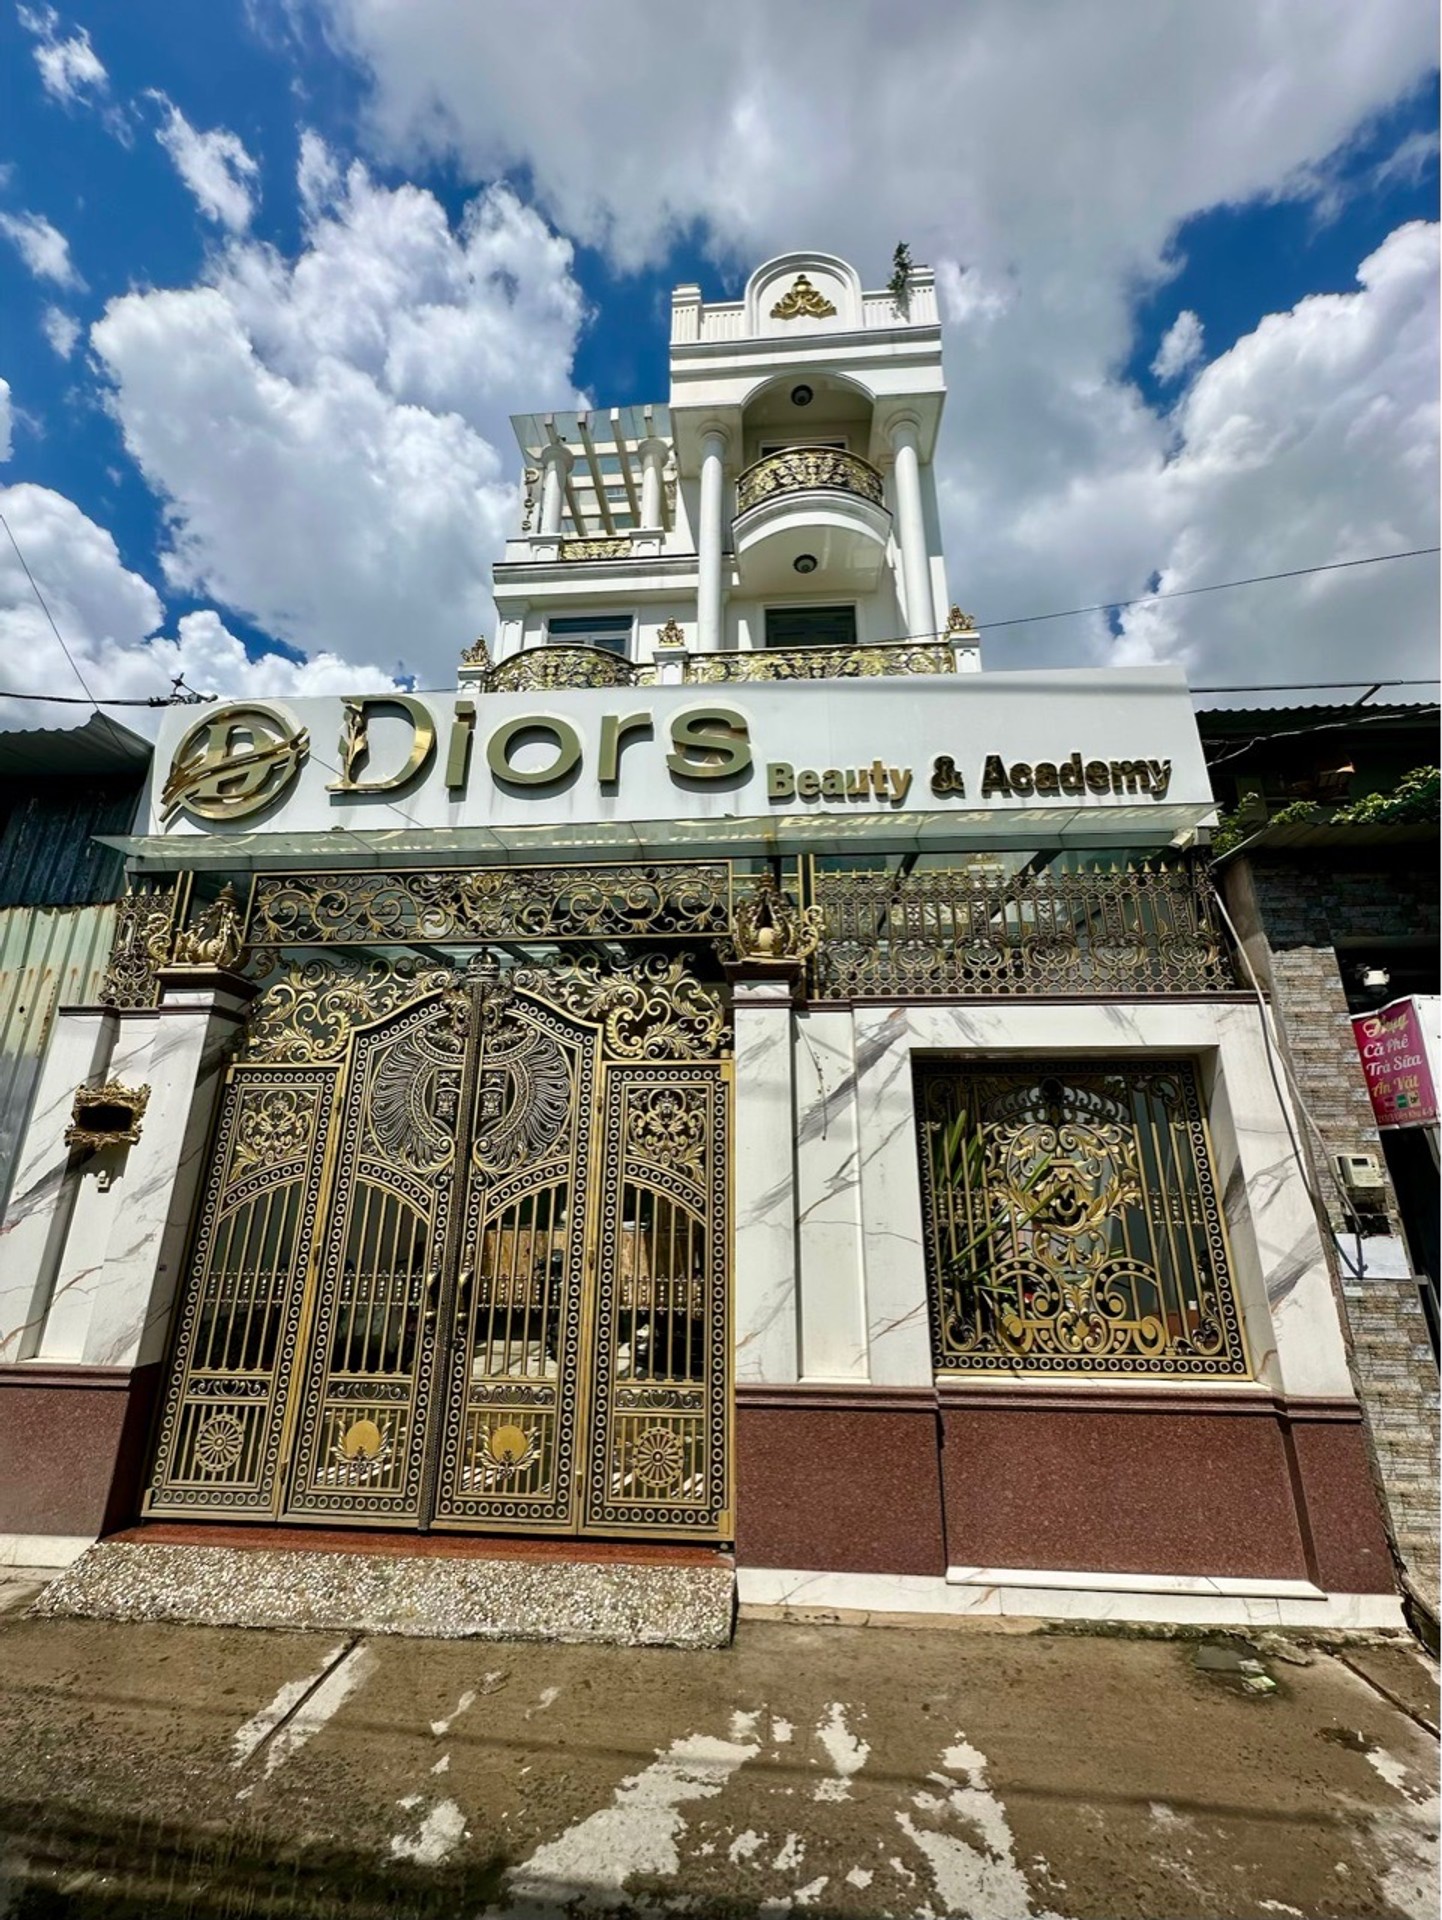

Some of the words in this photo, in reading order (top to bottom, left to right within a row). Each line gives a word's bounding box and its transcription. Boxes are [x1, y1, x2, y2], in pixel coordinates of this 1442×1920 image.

[325, 695, 756, 793] Diors
[767, 759, 913, 800] Beauty
[930, 755, 964, 793] &
[980, 751, 1172, 794] Academy
[1366, 1060, 1392, 1077] Trà
